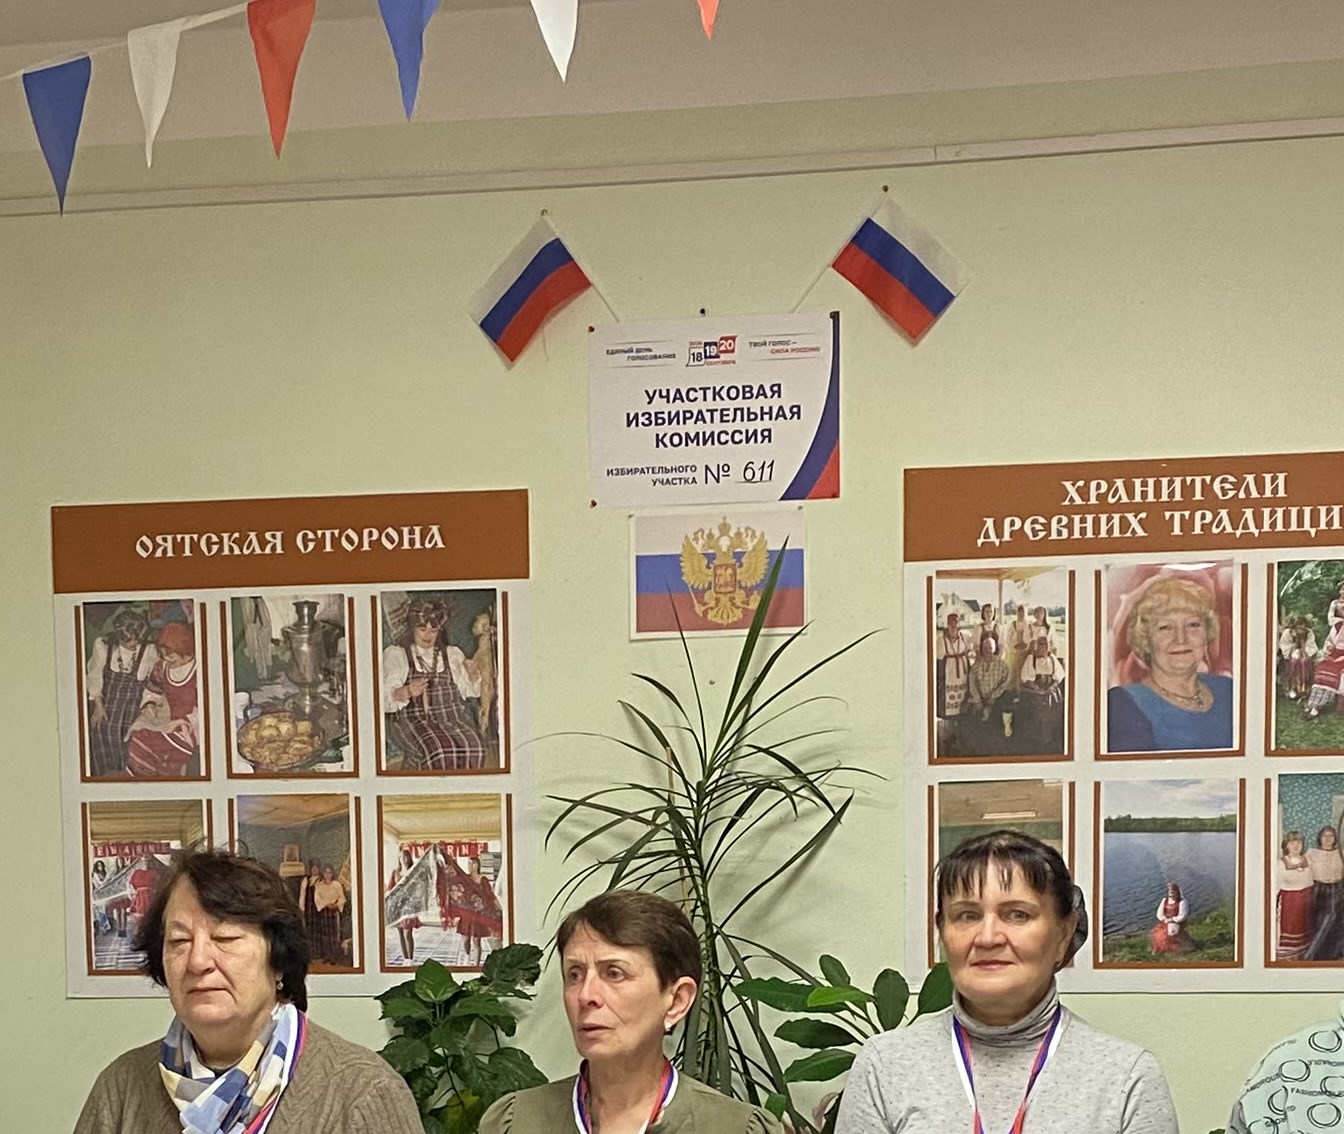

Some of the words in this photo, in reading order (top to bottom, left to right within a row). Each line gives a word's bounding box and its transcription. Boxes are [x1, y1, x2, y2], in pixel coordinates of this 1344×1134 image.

[691, 351, 703, 363] 18
[704, 345, 717, 357] 19
[719, 339, 735, 351] 20
[643, 383, 782, 406] УЧАСТКОВАЯ
[625, 404, 802, 428] ИЗБИРАТЕЛЬНАЯ
[655, 428, 773, 449] КОМИССИЯ
[605, 464, 698, 478] ИЗБИРАТЕЛЬНОГО
[651, 475, 698, 487] УЧАСТКА
[703, 463, 731, 485] №
[742, 459, 775, 483] 611
[1060, 471, 1288, 507] ХРАНИТЕЛИ
[976, 510, 1149, 548] ДРЕВНИХ
[134, 530, 285, 559] ОЯТСКАЯ
[295, 524, 446, 555] СТОРОНА
